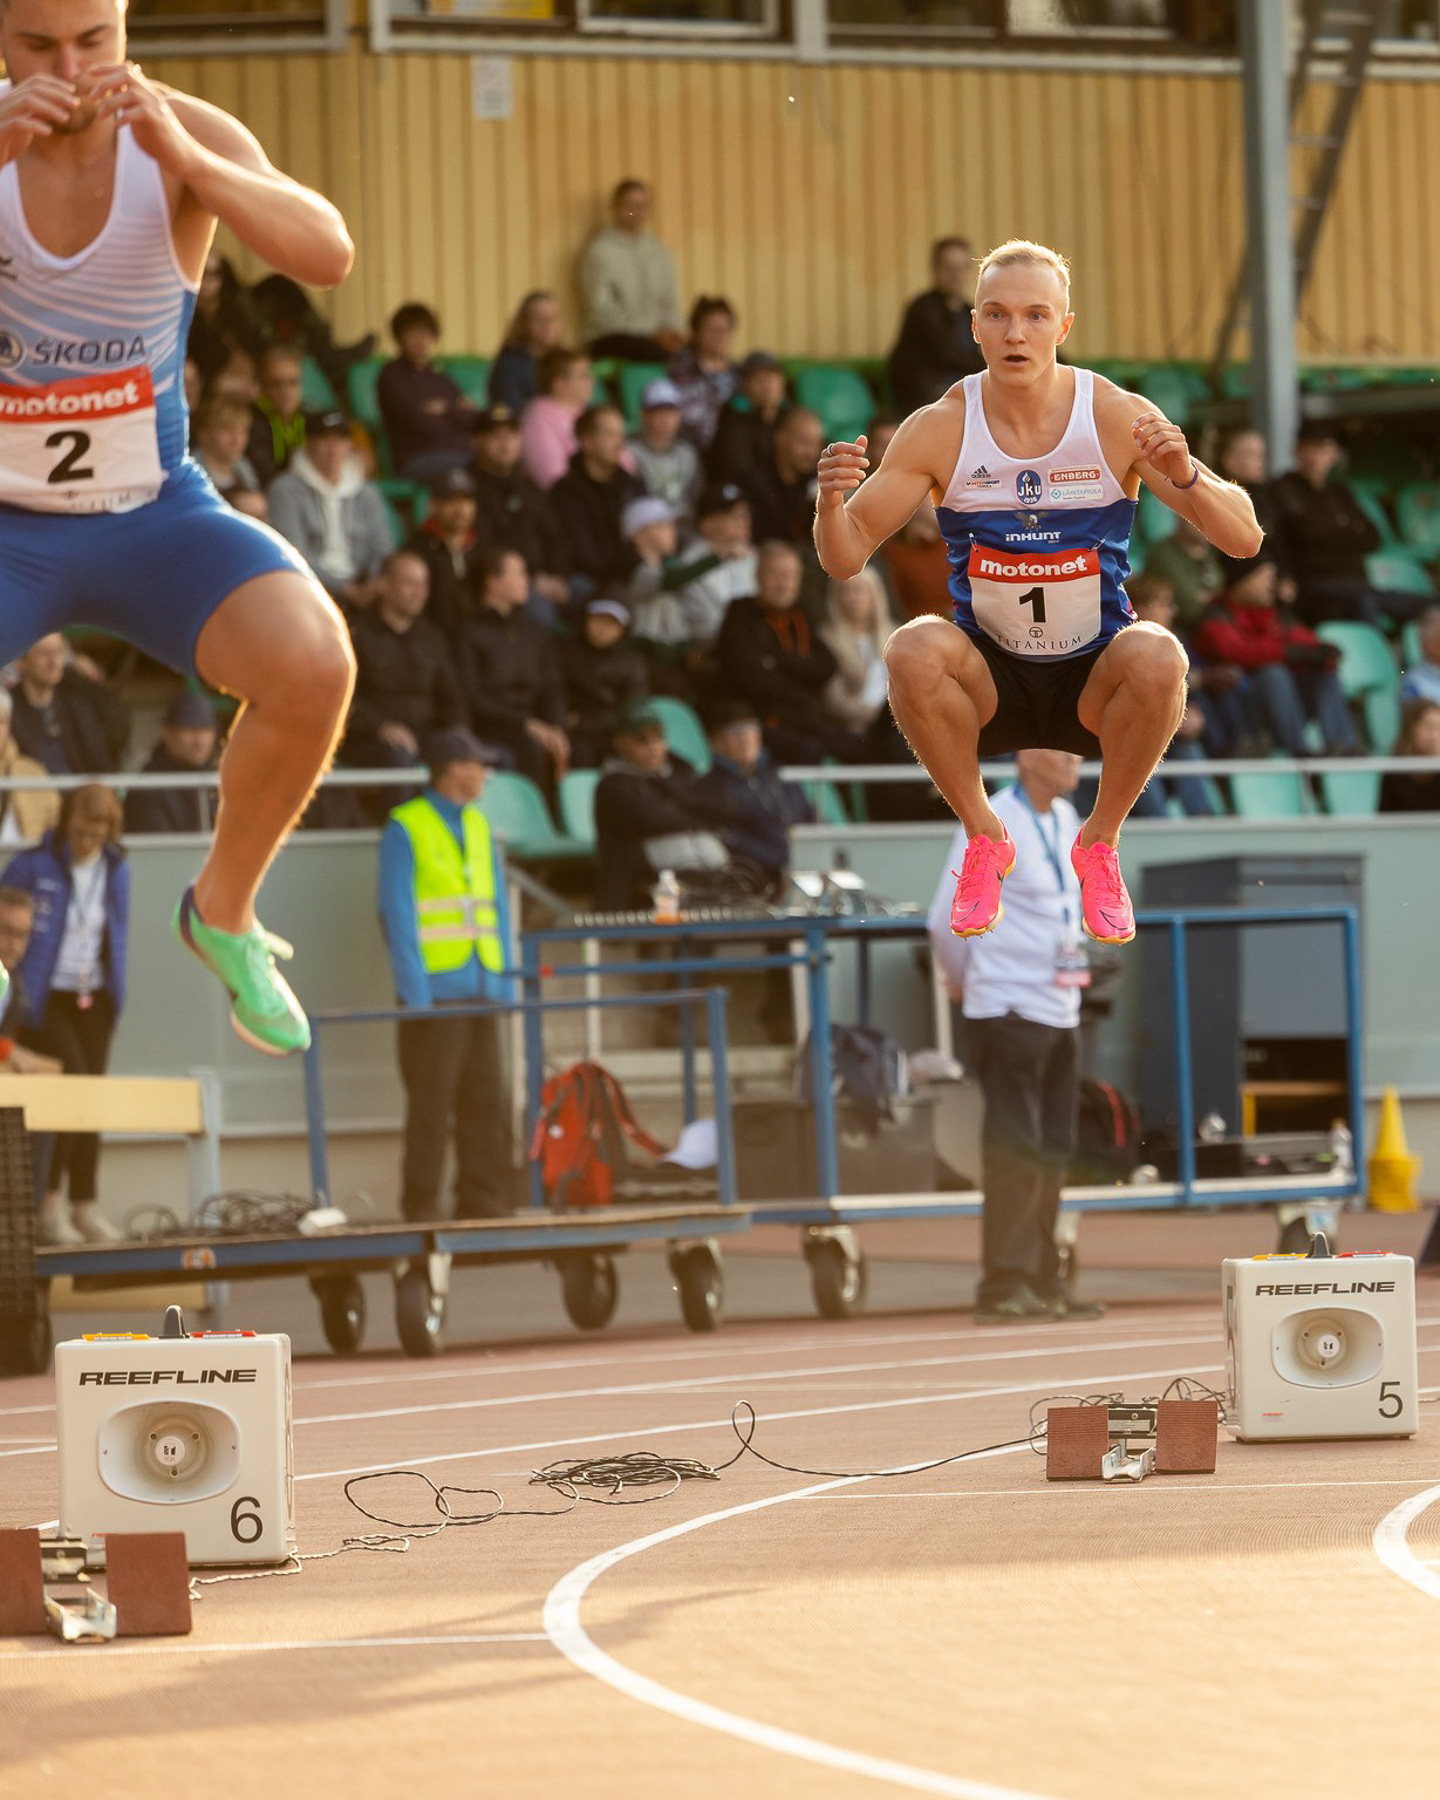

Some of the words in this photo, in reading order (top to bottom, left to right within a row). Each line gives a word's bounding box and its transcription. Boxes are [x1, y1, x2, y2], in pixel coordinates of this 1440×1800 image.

[45, 430, 94, 485] 2
[1053, 471, 1096, 481] ENBERG
[980, 555, 1088, 577] motonet
[1019, 587, 1046, 623] 1
[995, 633, 1082, 650] TITANIUM
[1255, 1281, 1396, 1296] REEFLINE
[79, 1369, 257, 1386] REEFLINE
[1378, 1381, 1404, 1418] 5
[230, 1496, 264, 1544] 6
